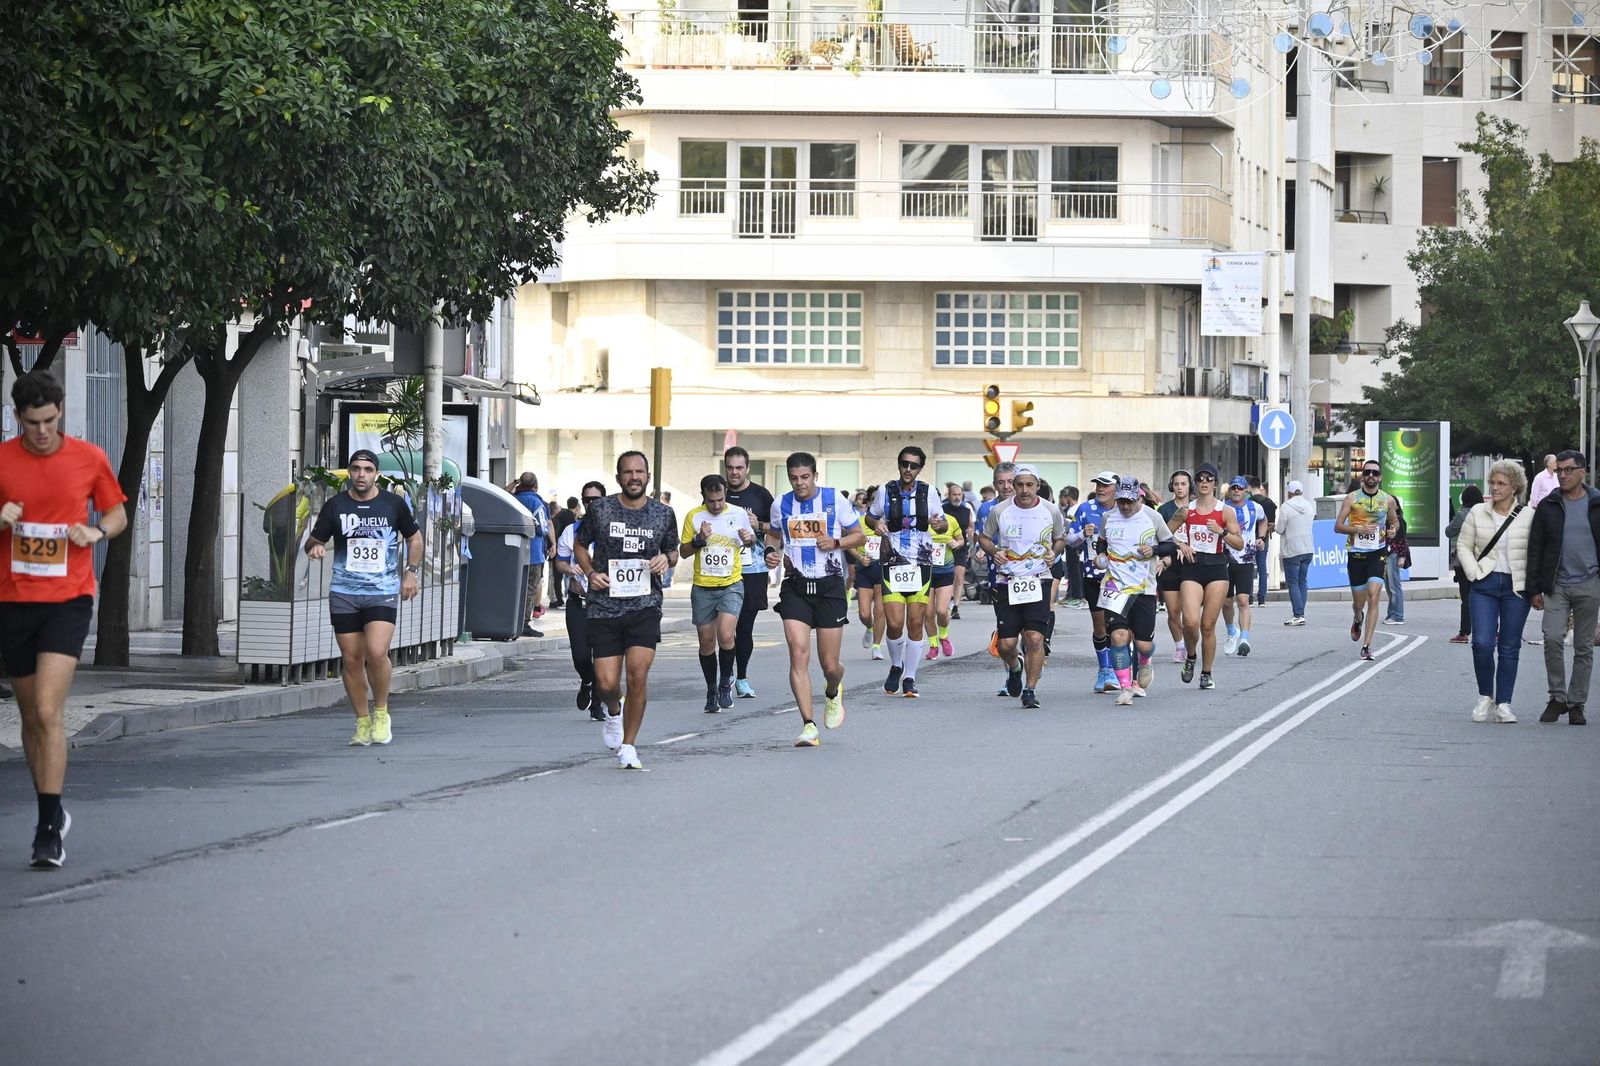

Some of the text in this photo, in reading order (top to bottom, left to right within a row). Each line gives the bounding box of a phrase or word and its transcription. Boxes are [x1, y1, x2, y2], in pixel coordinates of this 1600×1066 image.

[339, 513, 359, 536] 10
[358, 516, 389, 527] HUELVA
[793, 520, 820, 534] 430
[611, 525, 654, 539] Running
[1194, 531, 1214, 544] 695
[1358, 532, 1376, 541] 649
[20, 537, 58, 557] 529
[624, 540, 645, 550] Bad
[353, 546, 379, 560] 938
[705, 554, 728, 566] 696
[1312, 544, 1348, 566] Huelv
[616, 568, 644, 582] 607
[894, 571, 916, 582] 687
[1013, 580, 1036, 593] 626
